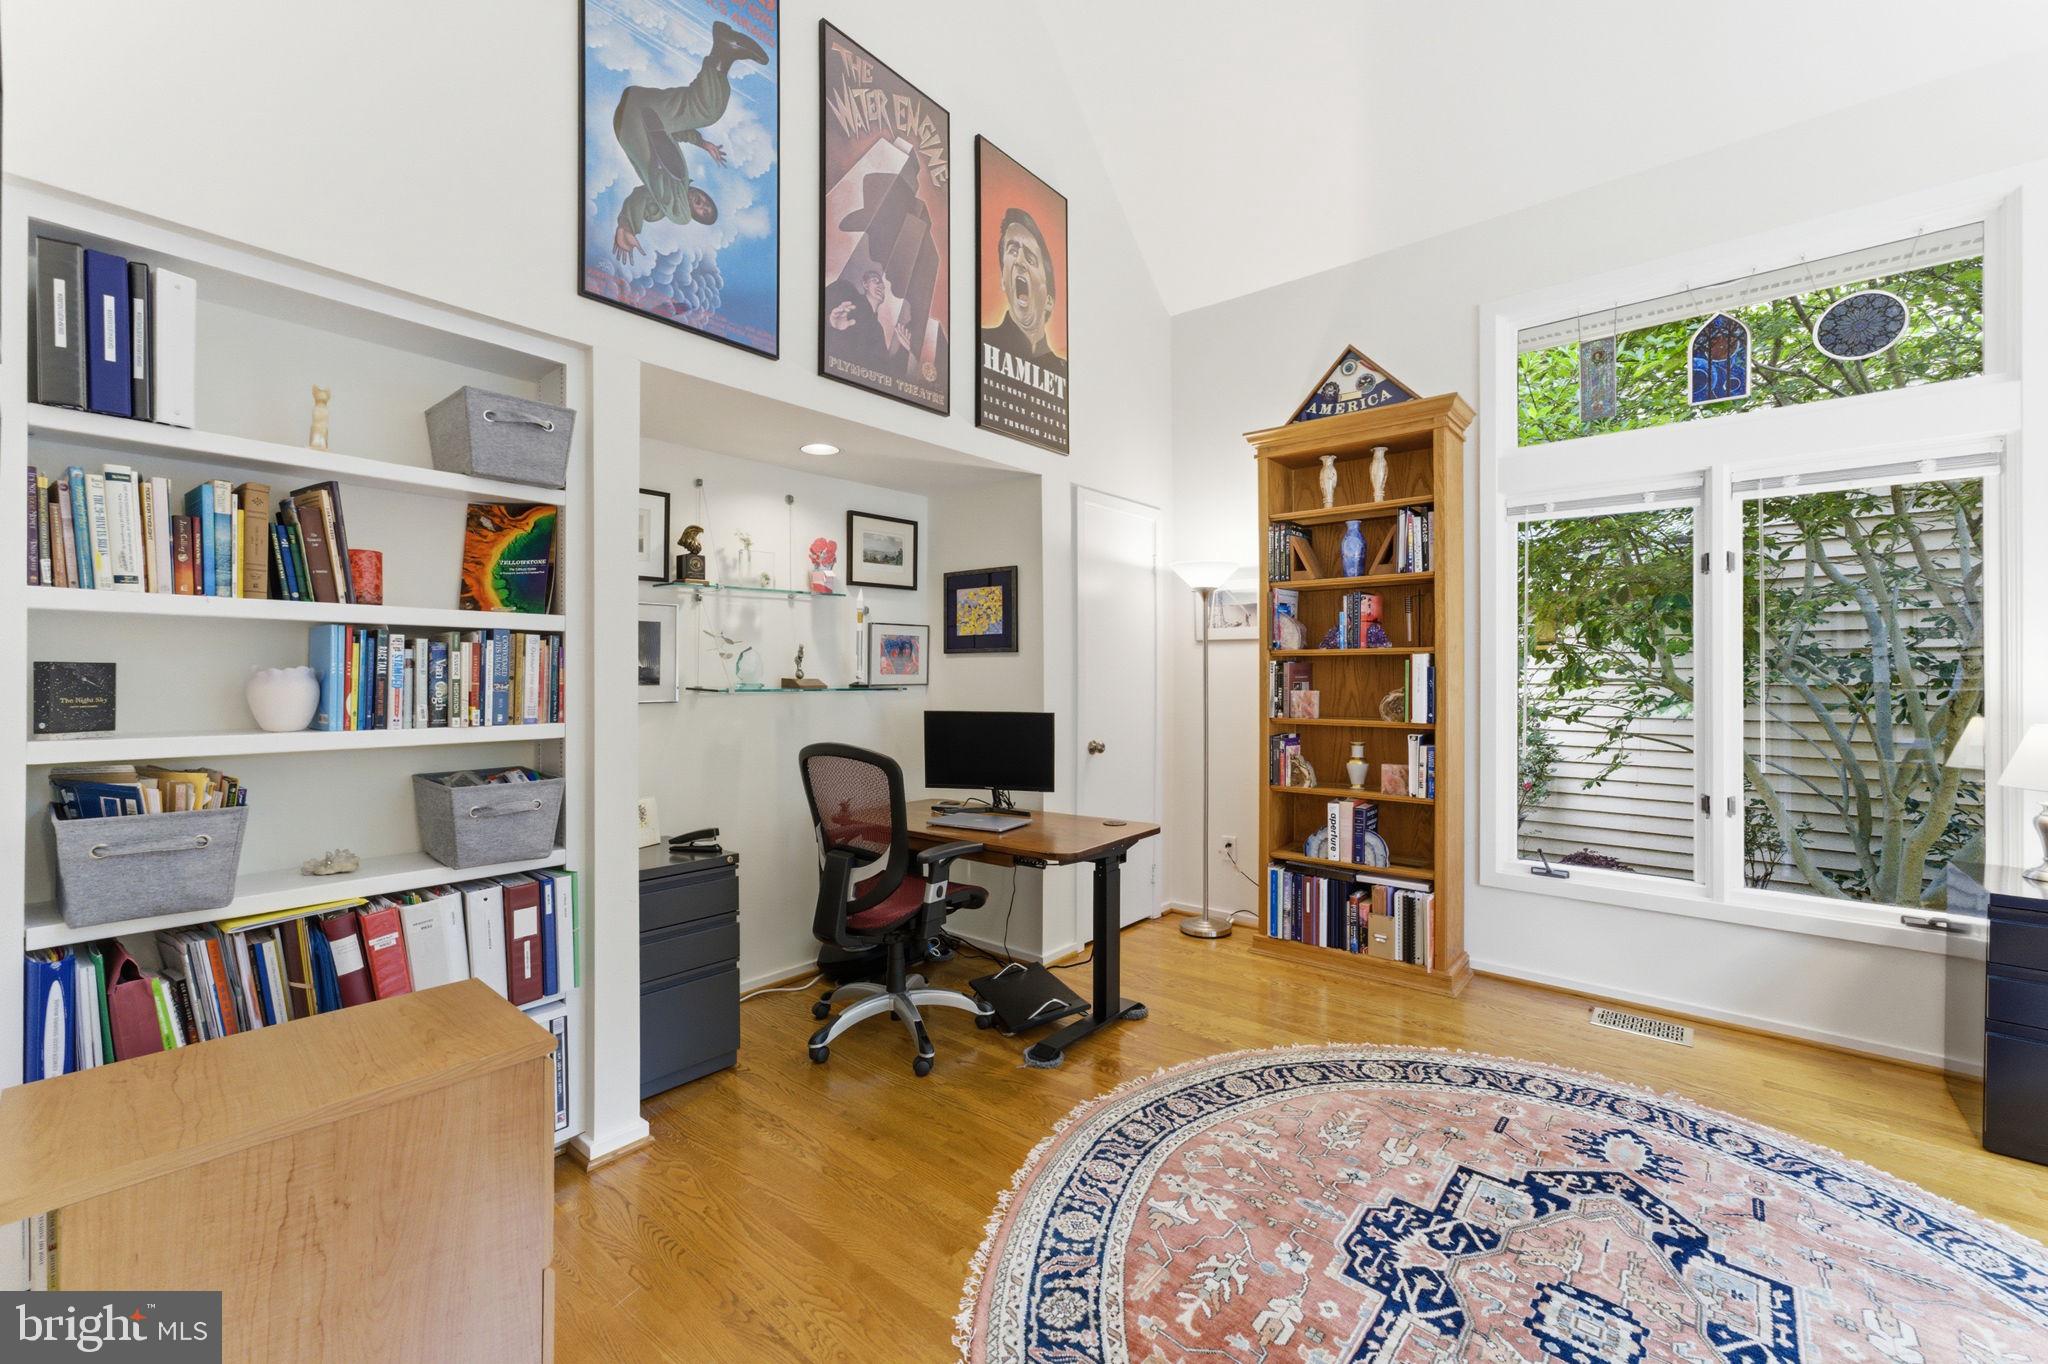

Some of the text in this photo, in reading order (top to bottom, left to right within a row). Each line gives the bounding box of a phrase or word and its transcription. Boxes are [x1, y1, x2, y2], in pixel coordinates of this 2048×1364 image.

[831, 42, 874, 86] THE
[826, 72, 949, 188] WATER ENGINE
[829, 355, 945, 405] PLYMOUTH THEATRE
[983, 342, 1067, 400] HAMLET
[983, 394, 1067, 430] LINCOLN CENTER
[1305, 389, 1393, 416] AMERICA
[983, 411, 999, 422] NOW
[1004, 418, 1040, 436] THROUGH
[377, 645, 387, 660] RACE
[377, 661, 387, 675] TALK
[391, 654, 403, 689] STAMPED
[432, 658, 447, 711] Van Gogh
[1330, 813, 1338, 851] aperture
